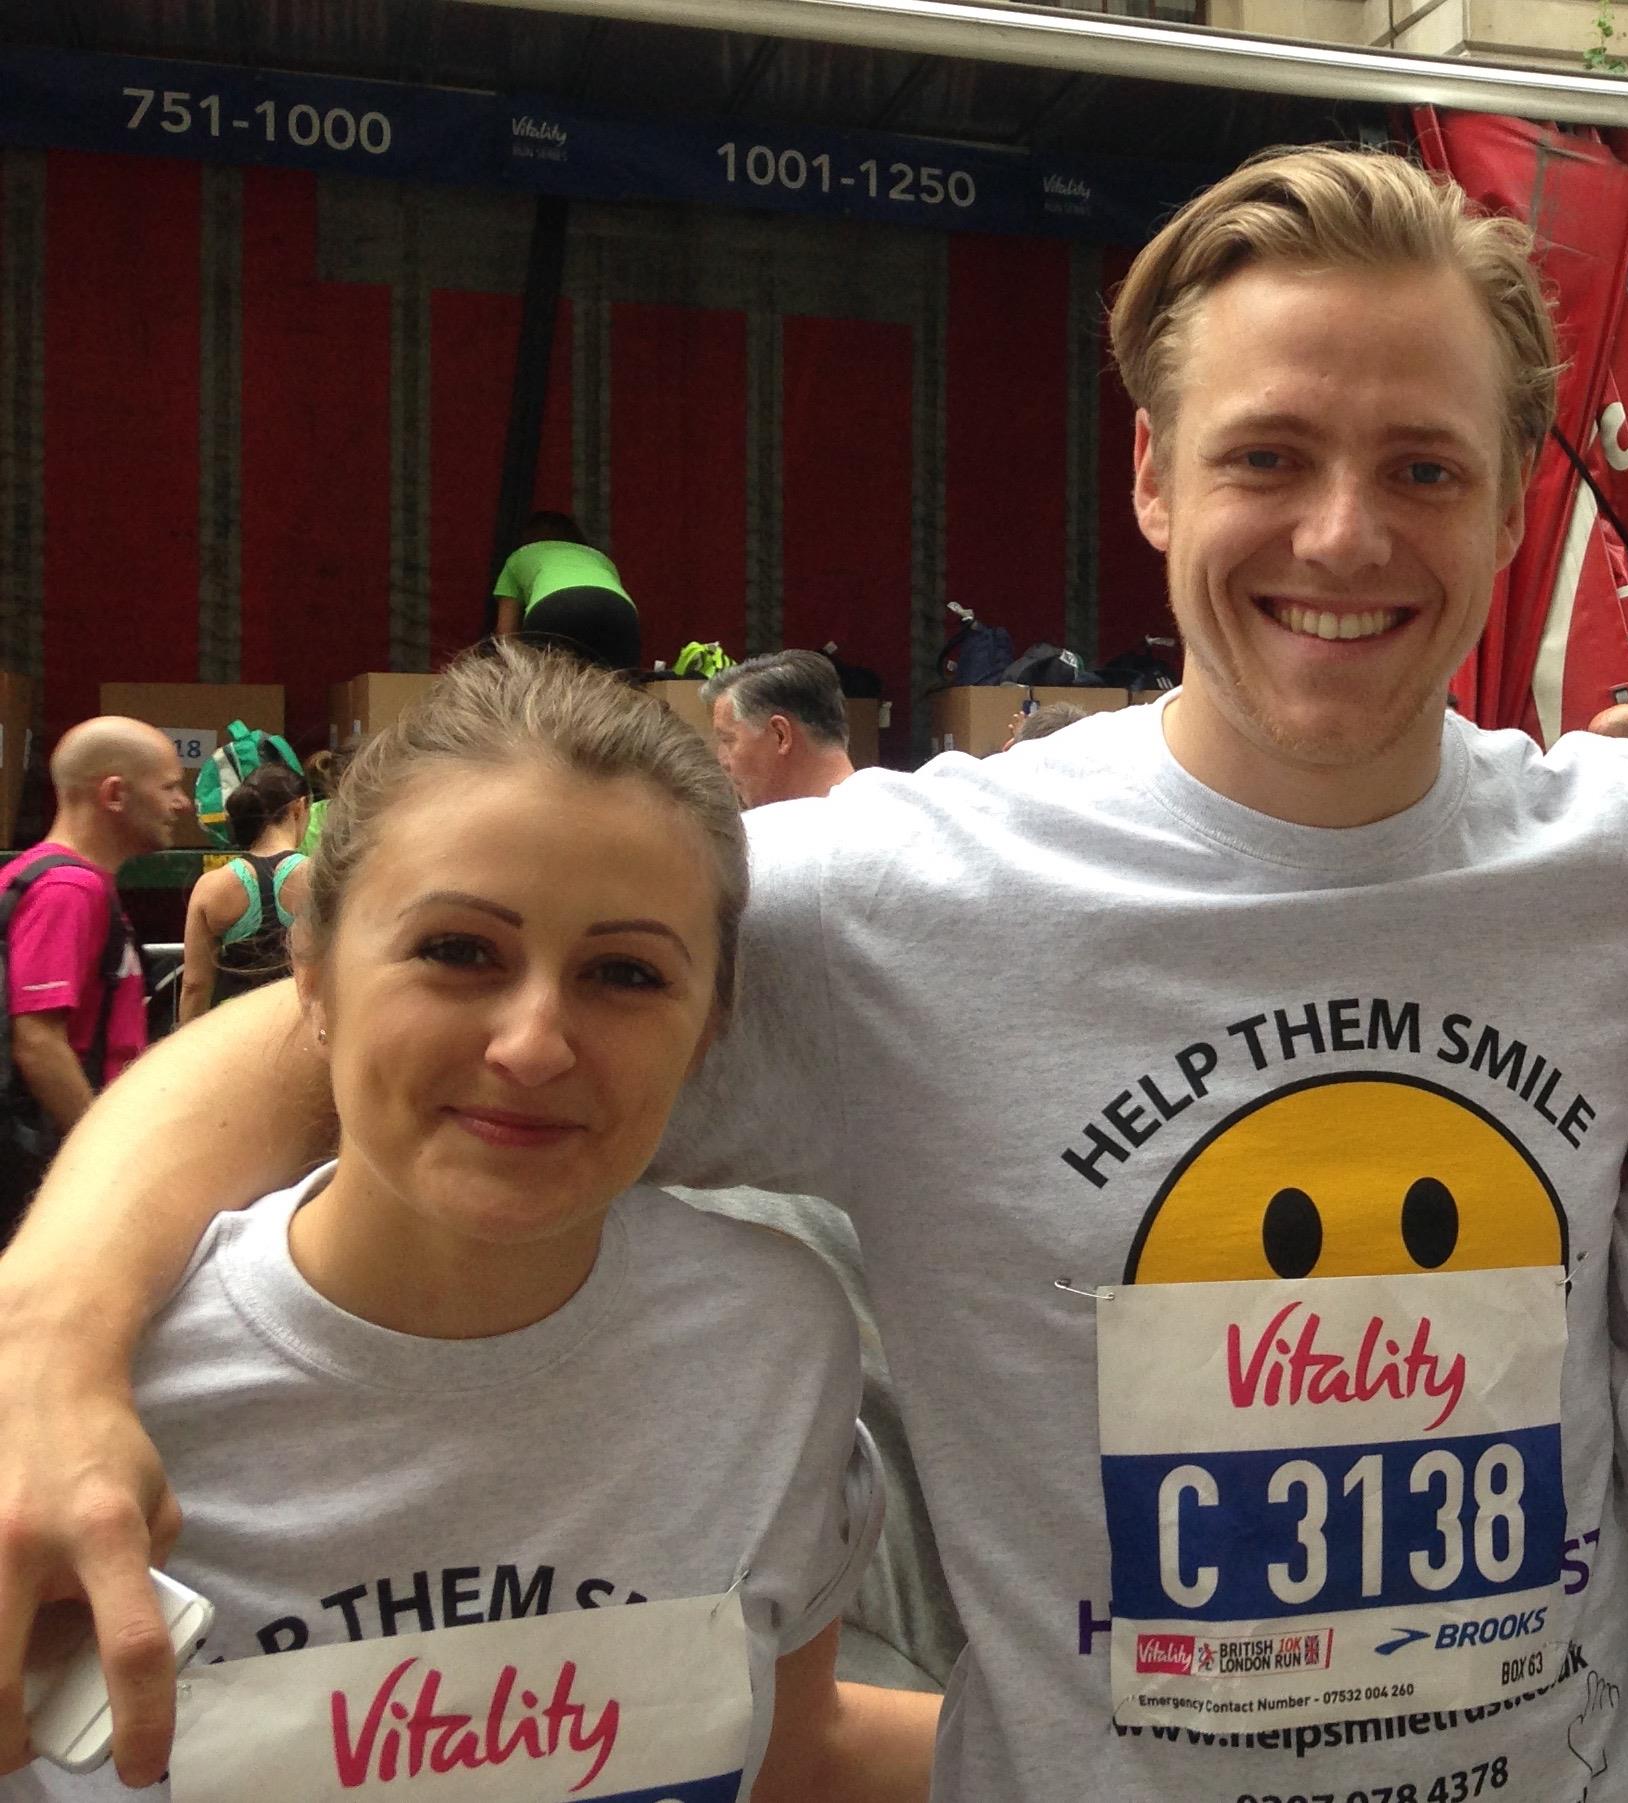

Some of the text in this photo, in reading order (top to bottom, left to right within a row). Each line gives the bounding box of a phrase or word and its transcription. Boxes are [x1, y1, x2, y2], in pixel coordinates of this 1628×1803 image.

[121, 87, 392, 155] 751-1000
[716, 141, 976, 208] 1001-1250
[174, 739, 201, 759] 18
[1061, 998, 1596, 1189] HELP THEM SMILE
[1226, 1301, 1467, 1432] Vitality
[1158, 1464, 1219, 1608] C
[1266, 1443, 1526, 1604] 3138
[321, 1564, 555, 1644] THEM
[1219, 1636, 1303, 1658] BRITISH 10K
[1434, 1606, 1548, 1650] BROOKS
[1138, 1637, 1193, 1671] Vitality
[1219, 1652, 1301, 1673] LONDON RUN
[1501, 1651, 1544, 1687] BOX 63
[1138, 1694, 1203, 1713] Emergency
[1206, 1699, 1254, 1714] Contact
[1257, 1695, 1309, 1711] Number
[1323, 1687, 1362, 1705] 07532
[1365, 1685, 1388, 1700] 004
[1391, 1683, 1414, 1697] 260
[331, 1656, 619, 1793] Vitality
[1427, 1756, 1508, 1803] 4378
